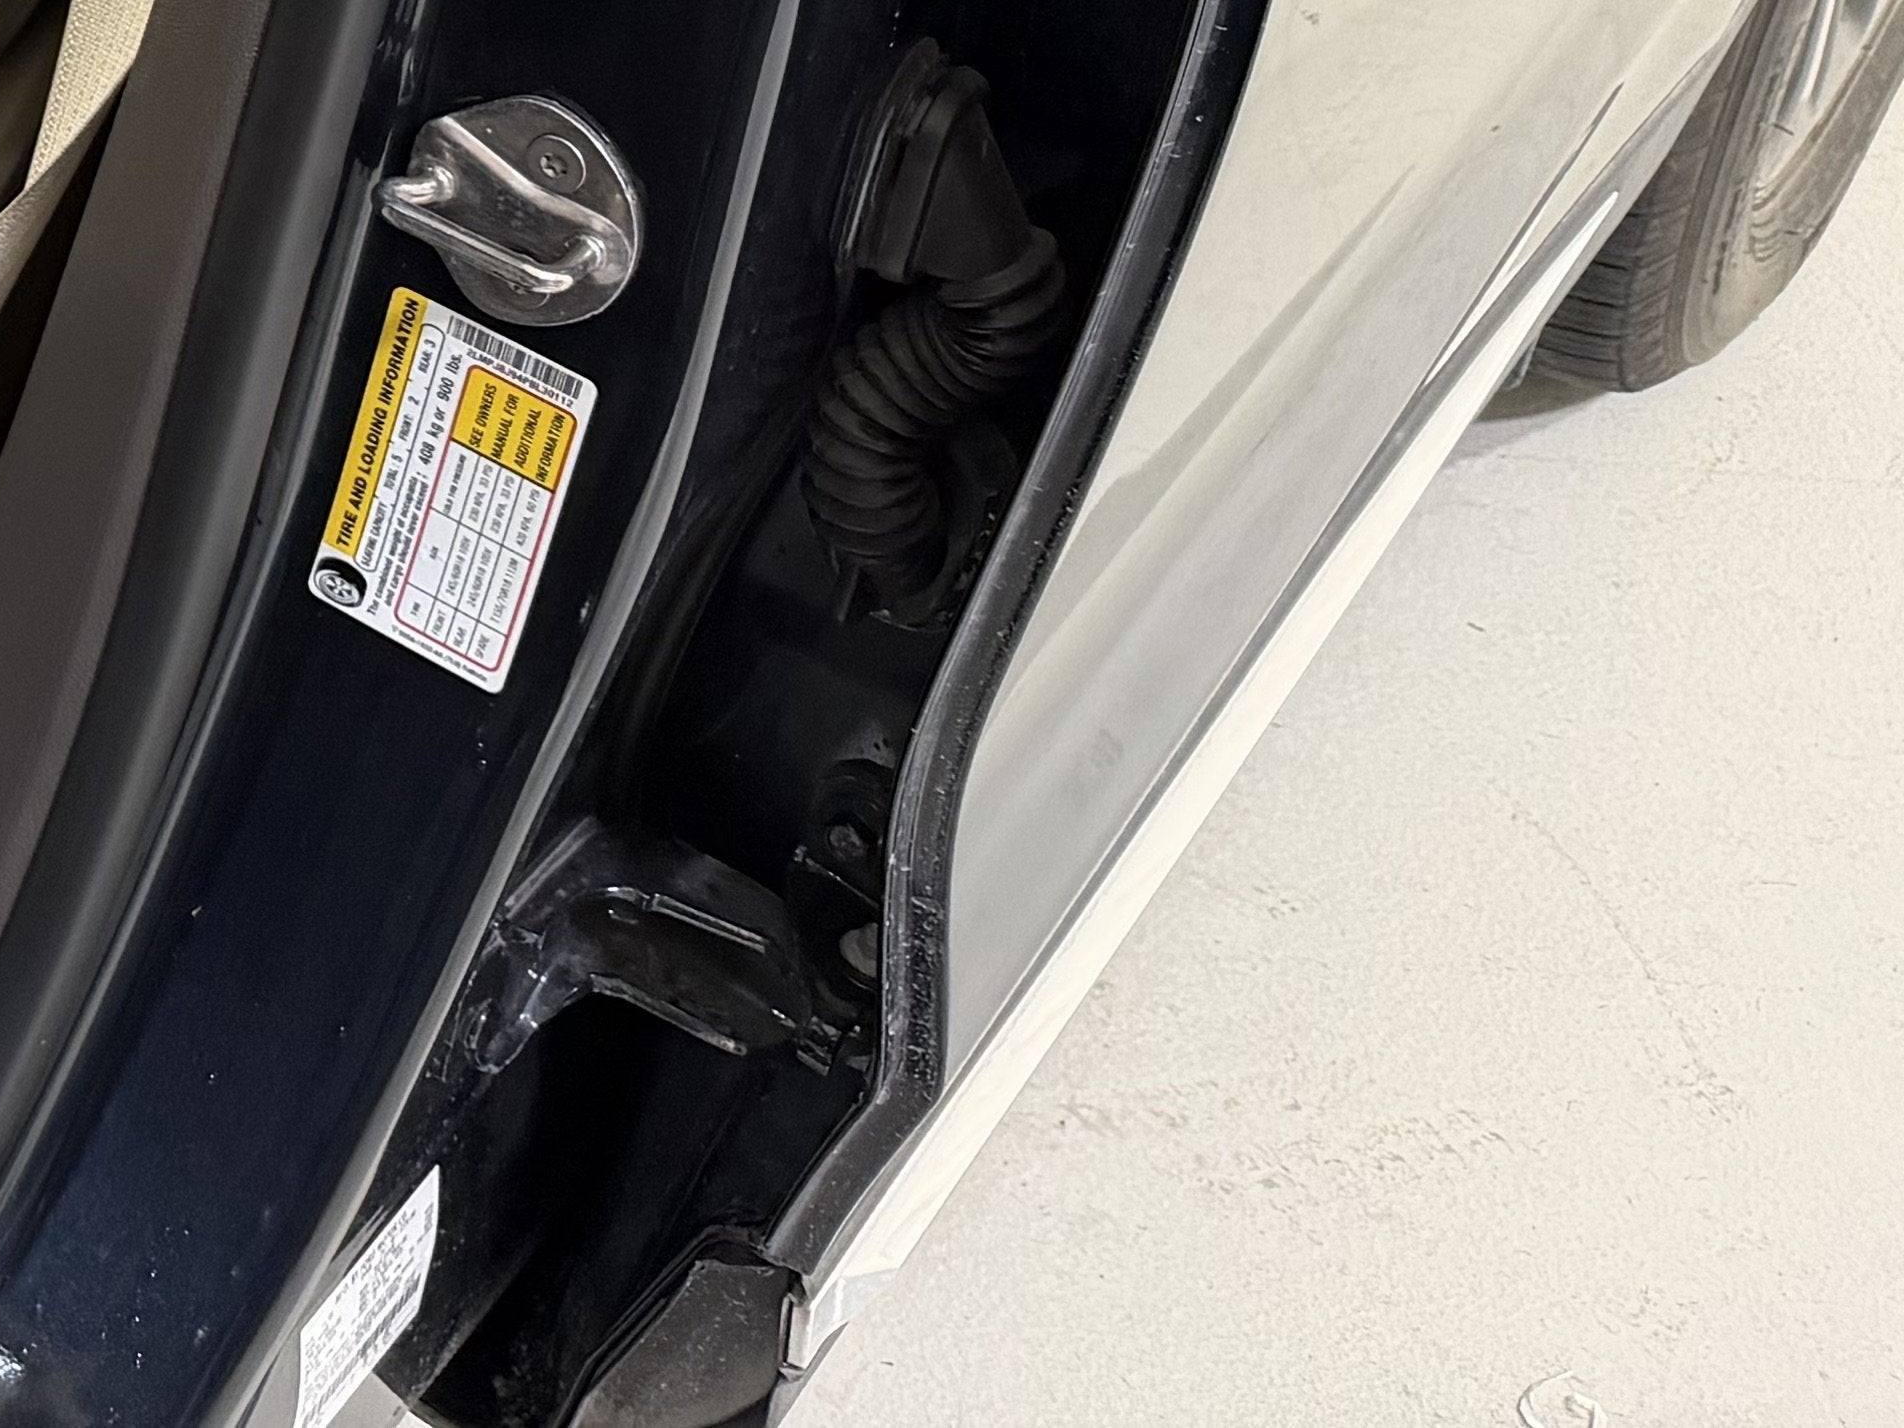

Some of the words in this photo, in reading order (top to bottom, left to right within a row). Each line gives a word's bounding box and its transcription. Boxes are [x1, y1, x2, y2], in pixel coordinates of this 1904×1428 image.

[377, 296, 420, 406] INFORMATION
[444, 354, 463, 376] lbs.
[436, 376, 455, 402] 900
[474, 382, 498, 428] OWNERS
[425, 421, 445, 439] kg
[433, 405, 446, 422] or
[490, 417, 514, 461] MANUAL
[502, 393, 520, 417] FOR
[357, 406, 388, 476] LOADING
[418, 441, 436, 466] 408
[468, 426, 484, 449] SEE
[513, 408, 542, 470] ADDITIONAL
[534, 411, 566, 483] INFORMATION
[348, 476, 368, 511] AND
[335, 509, 359, 547] TIRE
